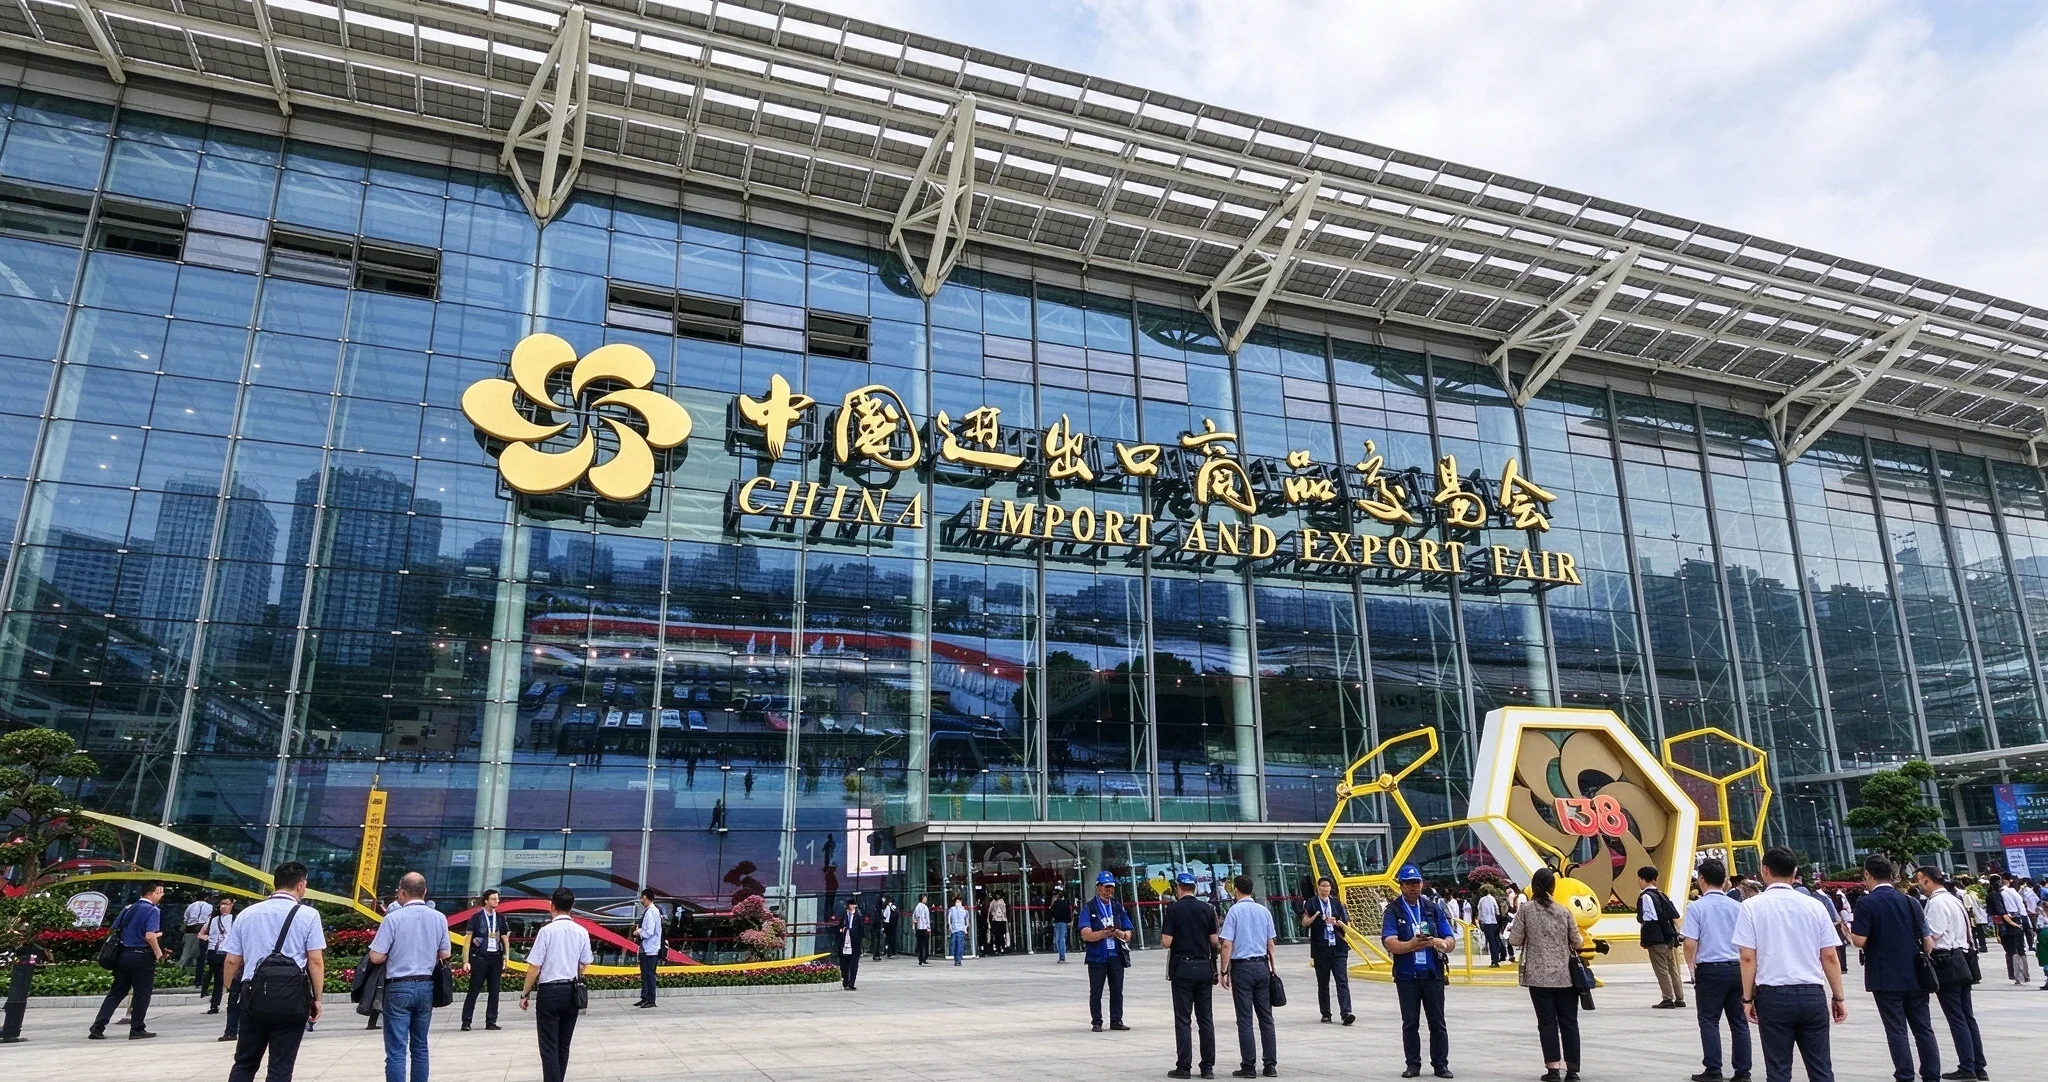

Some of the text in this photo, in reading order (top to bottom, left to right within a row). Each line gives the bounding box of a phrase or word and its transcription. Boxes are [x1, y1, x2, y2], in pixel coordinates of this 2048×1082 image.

[738, 476, 1582, 586] CHINA IMPORT AND EXPORT FAIR
[1555, 794, 1628, 838] 138
